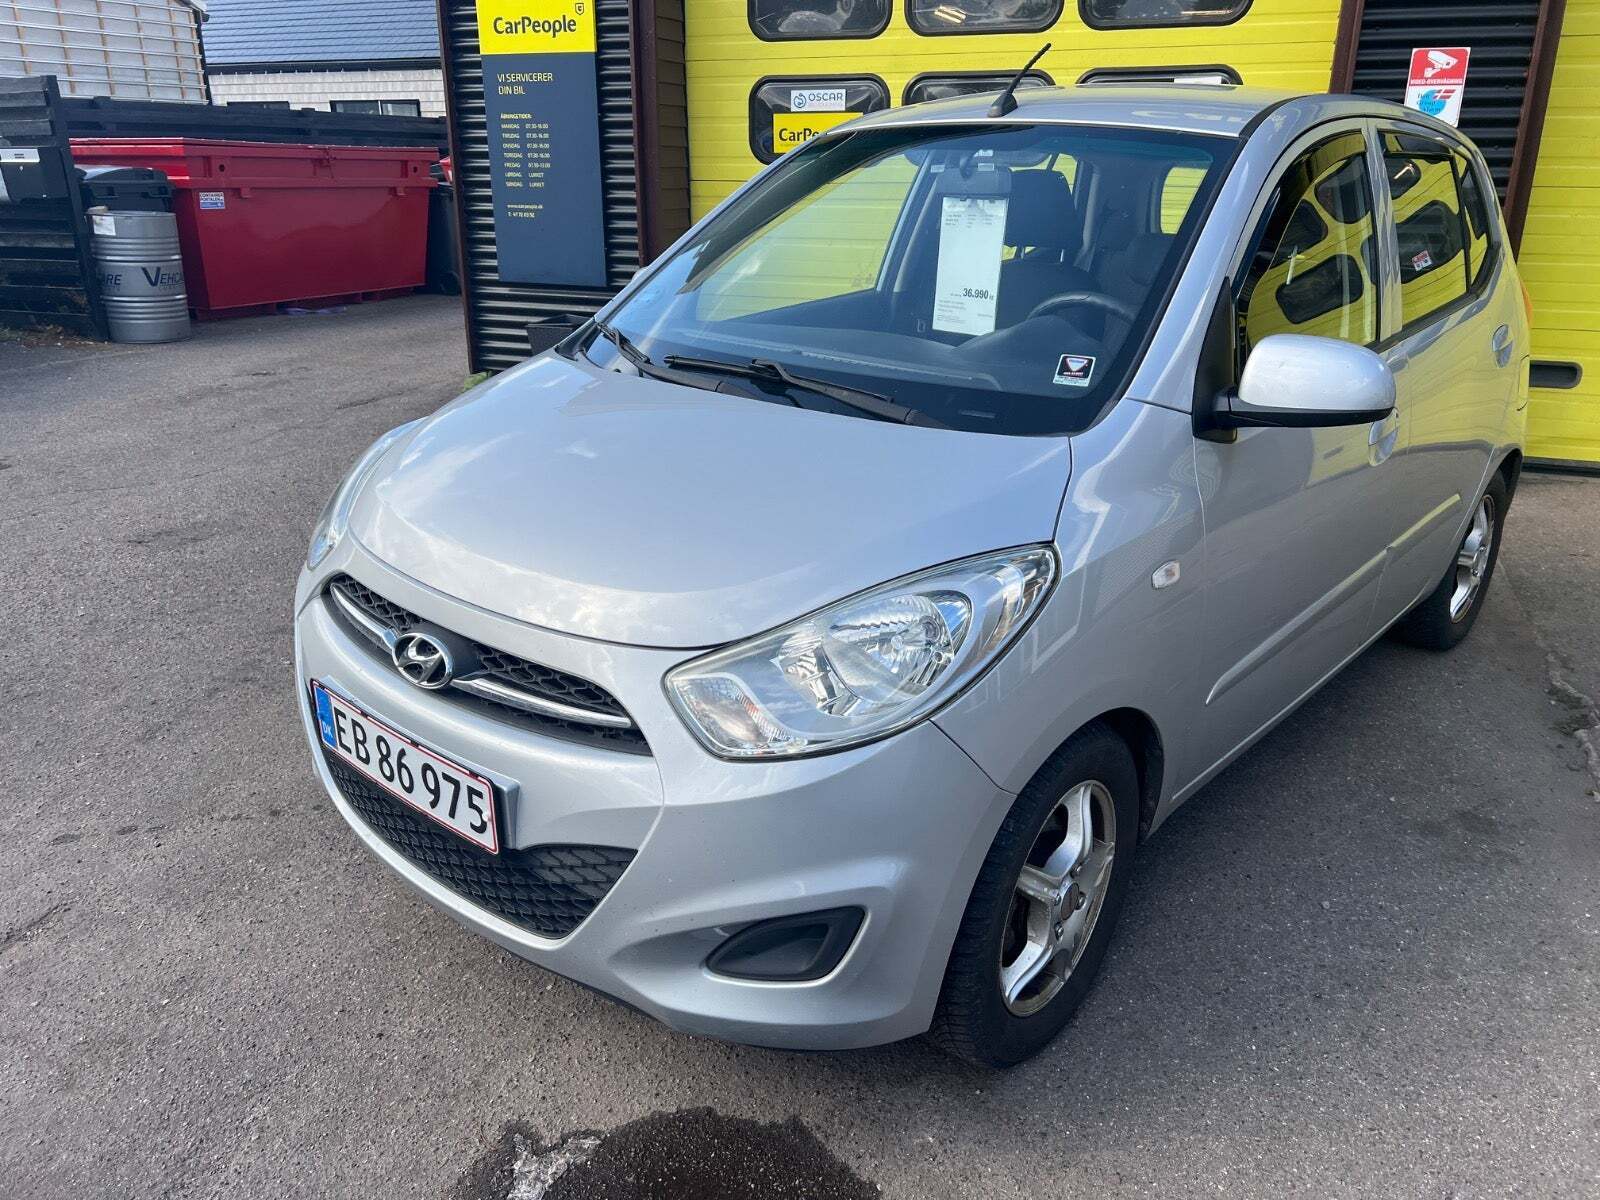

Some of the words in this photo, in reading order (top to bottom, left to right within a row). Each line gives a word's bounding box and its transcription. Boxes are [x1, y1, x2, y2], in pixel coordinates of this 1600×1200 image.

[493, 15, 577, 38] CarPeople
[497, 73, 505, 82] VI
[506, 73, 554, 82] SERVICERER
[498, 86, 512, 95] DIN
[513, 86, 526, 95] BIL
[808, 93, 843, 102] OSCAR
[778, 127, 820, 142] CarPe
[963, 288, 989, 300] 36.990
[321, 721, 334, 739] DK
[333, 707, 371, 765] EB
[375, 734, 415, 794] 86
[421, 762, 488, 834] 975
